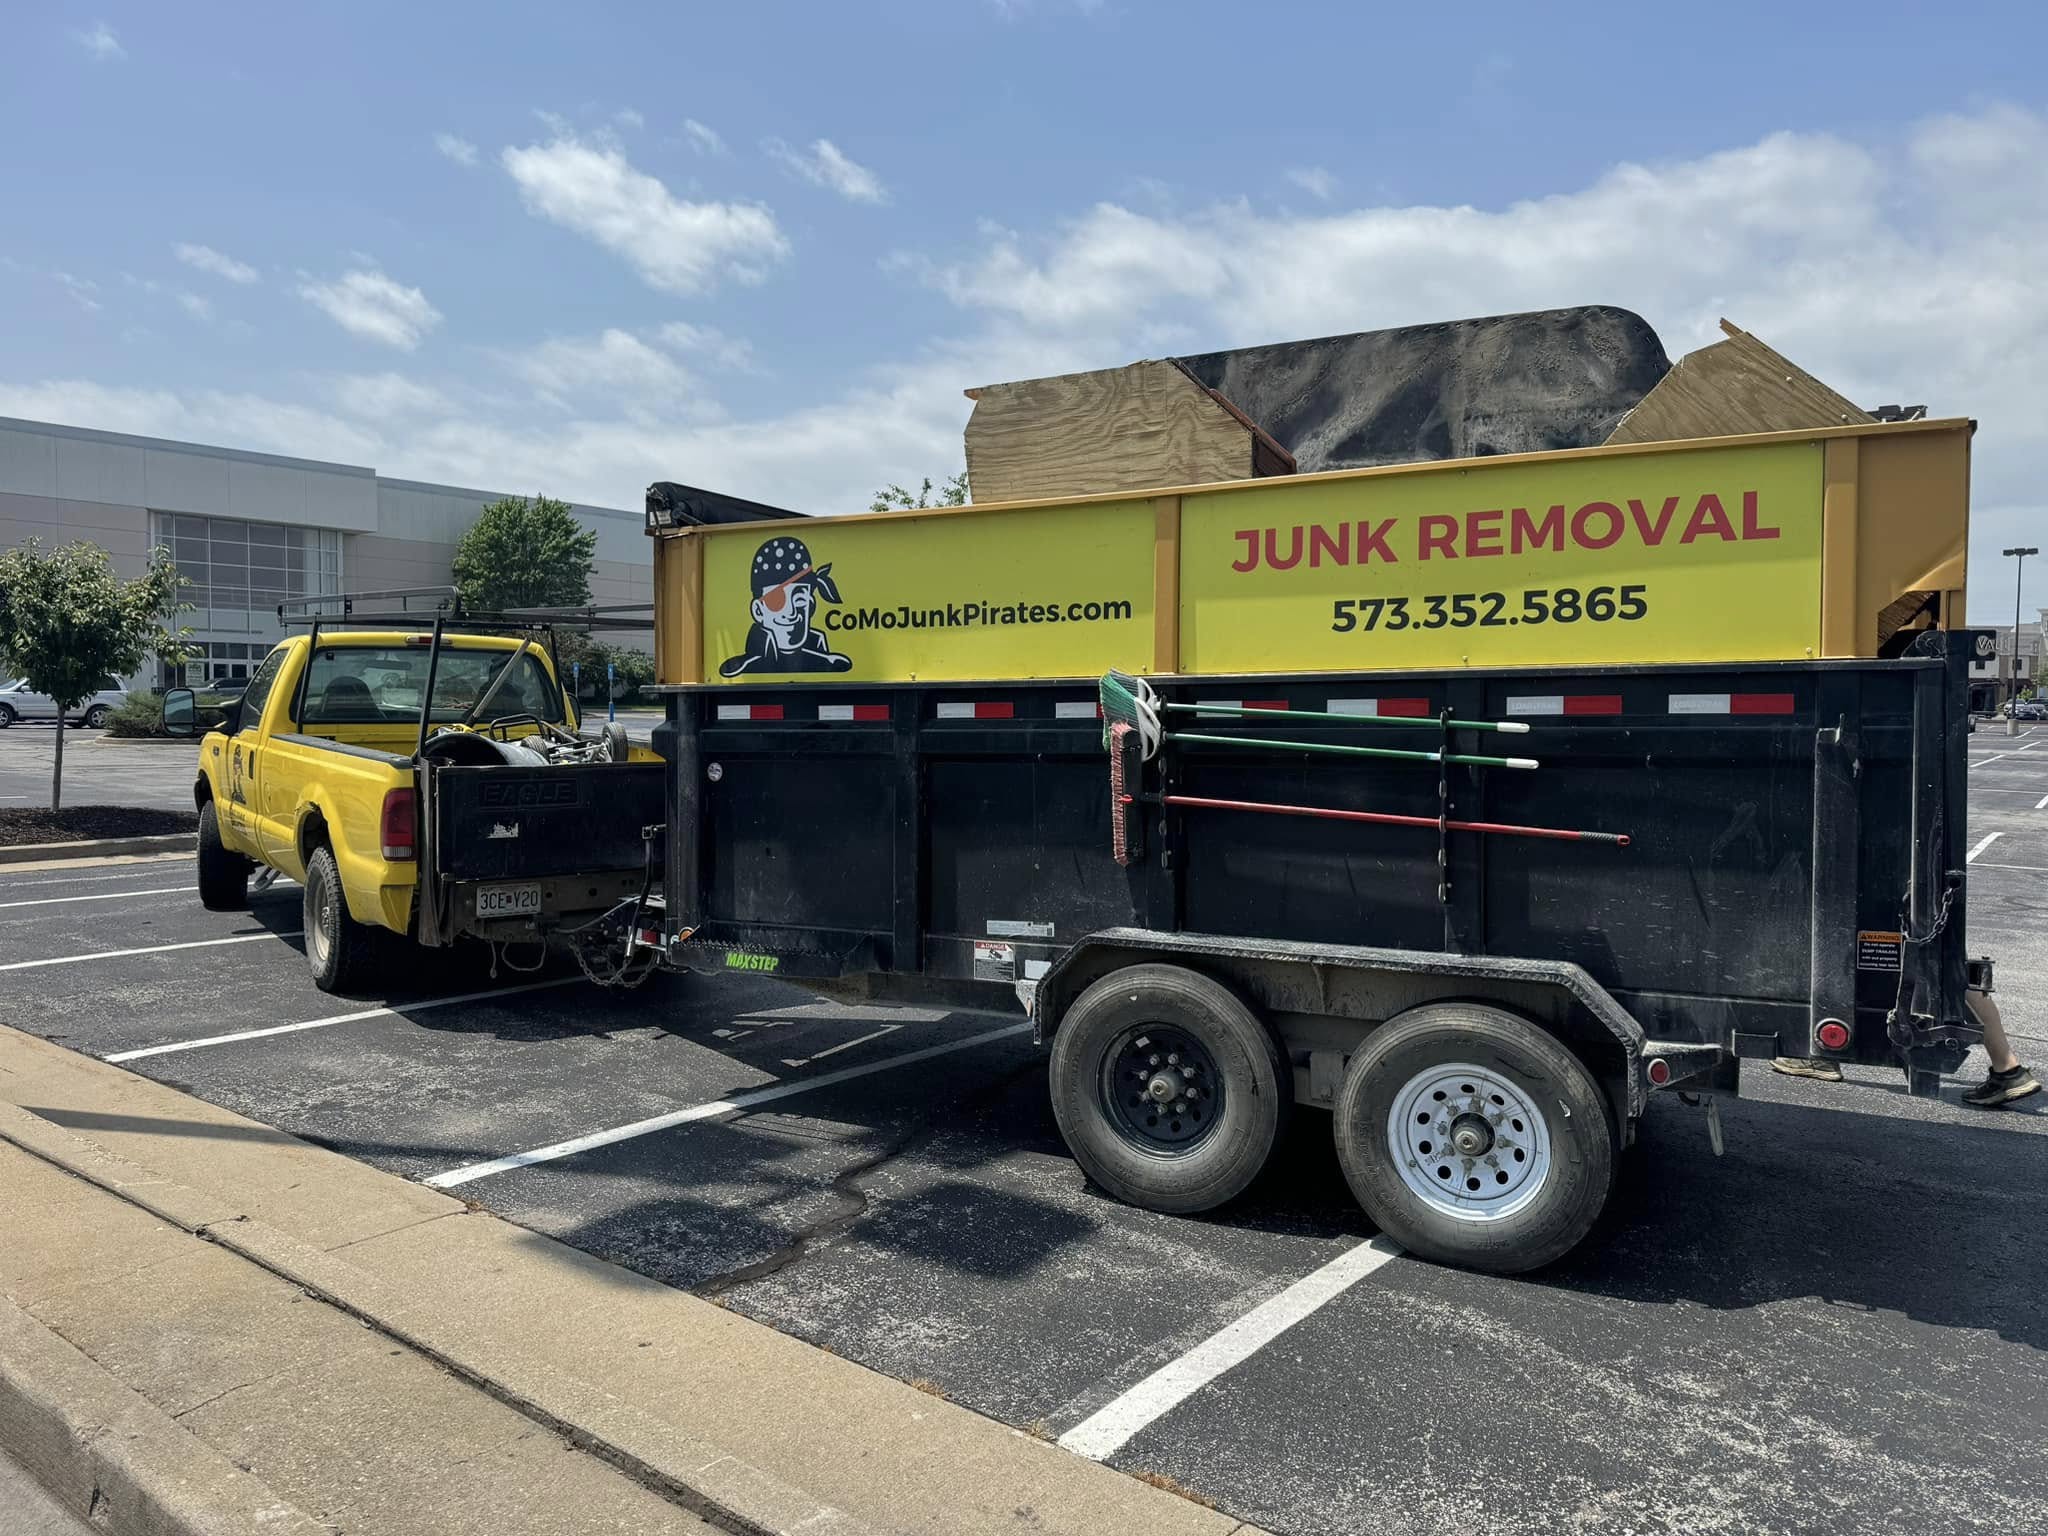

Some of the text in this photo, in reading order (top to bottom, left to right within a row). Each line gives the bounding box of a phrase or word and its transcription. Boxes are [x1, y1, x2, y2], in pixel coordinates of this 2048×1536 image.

[1232, 490, 1782, 573] JUNK REMOVAL
[824, 600, 1133, 632] CoMoJunkPirates.com
[1331, 584, 1649, 633] 573.352.5865
[483, 783, 573, 803] EAGLE
[480, 889, 539, 910] 3CE Y20
[725, 951, 779, 972] MAXSTEP
